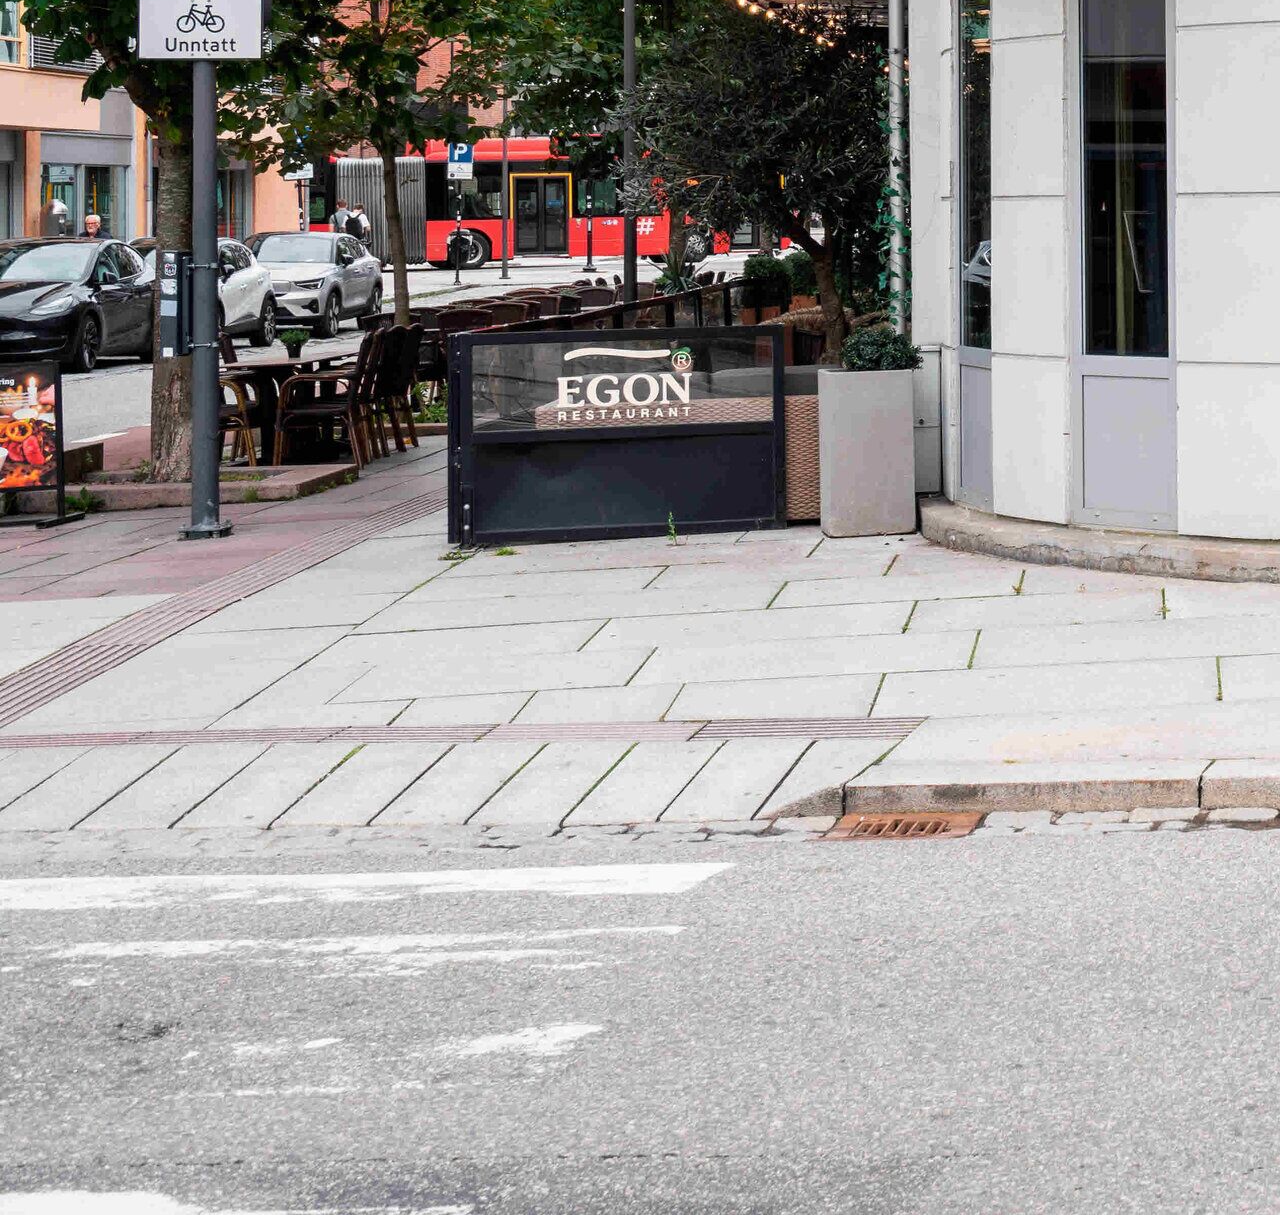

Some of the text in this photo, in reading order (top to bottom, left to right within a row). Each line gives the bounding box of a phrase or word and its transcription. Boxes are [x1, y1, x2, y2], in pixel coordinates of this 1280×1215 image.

[165, 37, 237, 52] Unntatt
[556, 372, 693, 409] EGON
[557, 406, 691, 423] RESTAURANT
